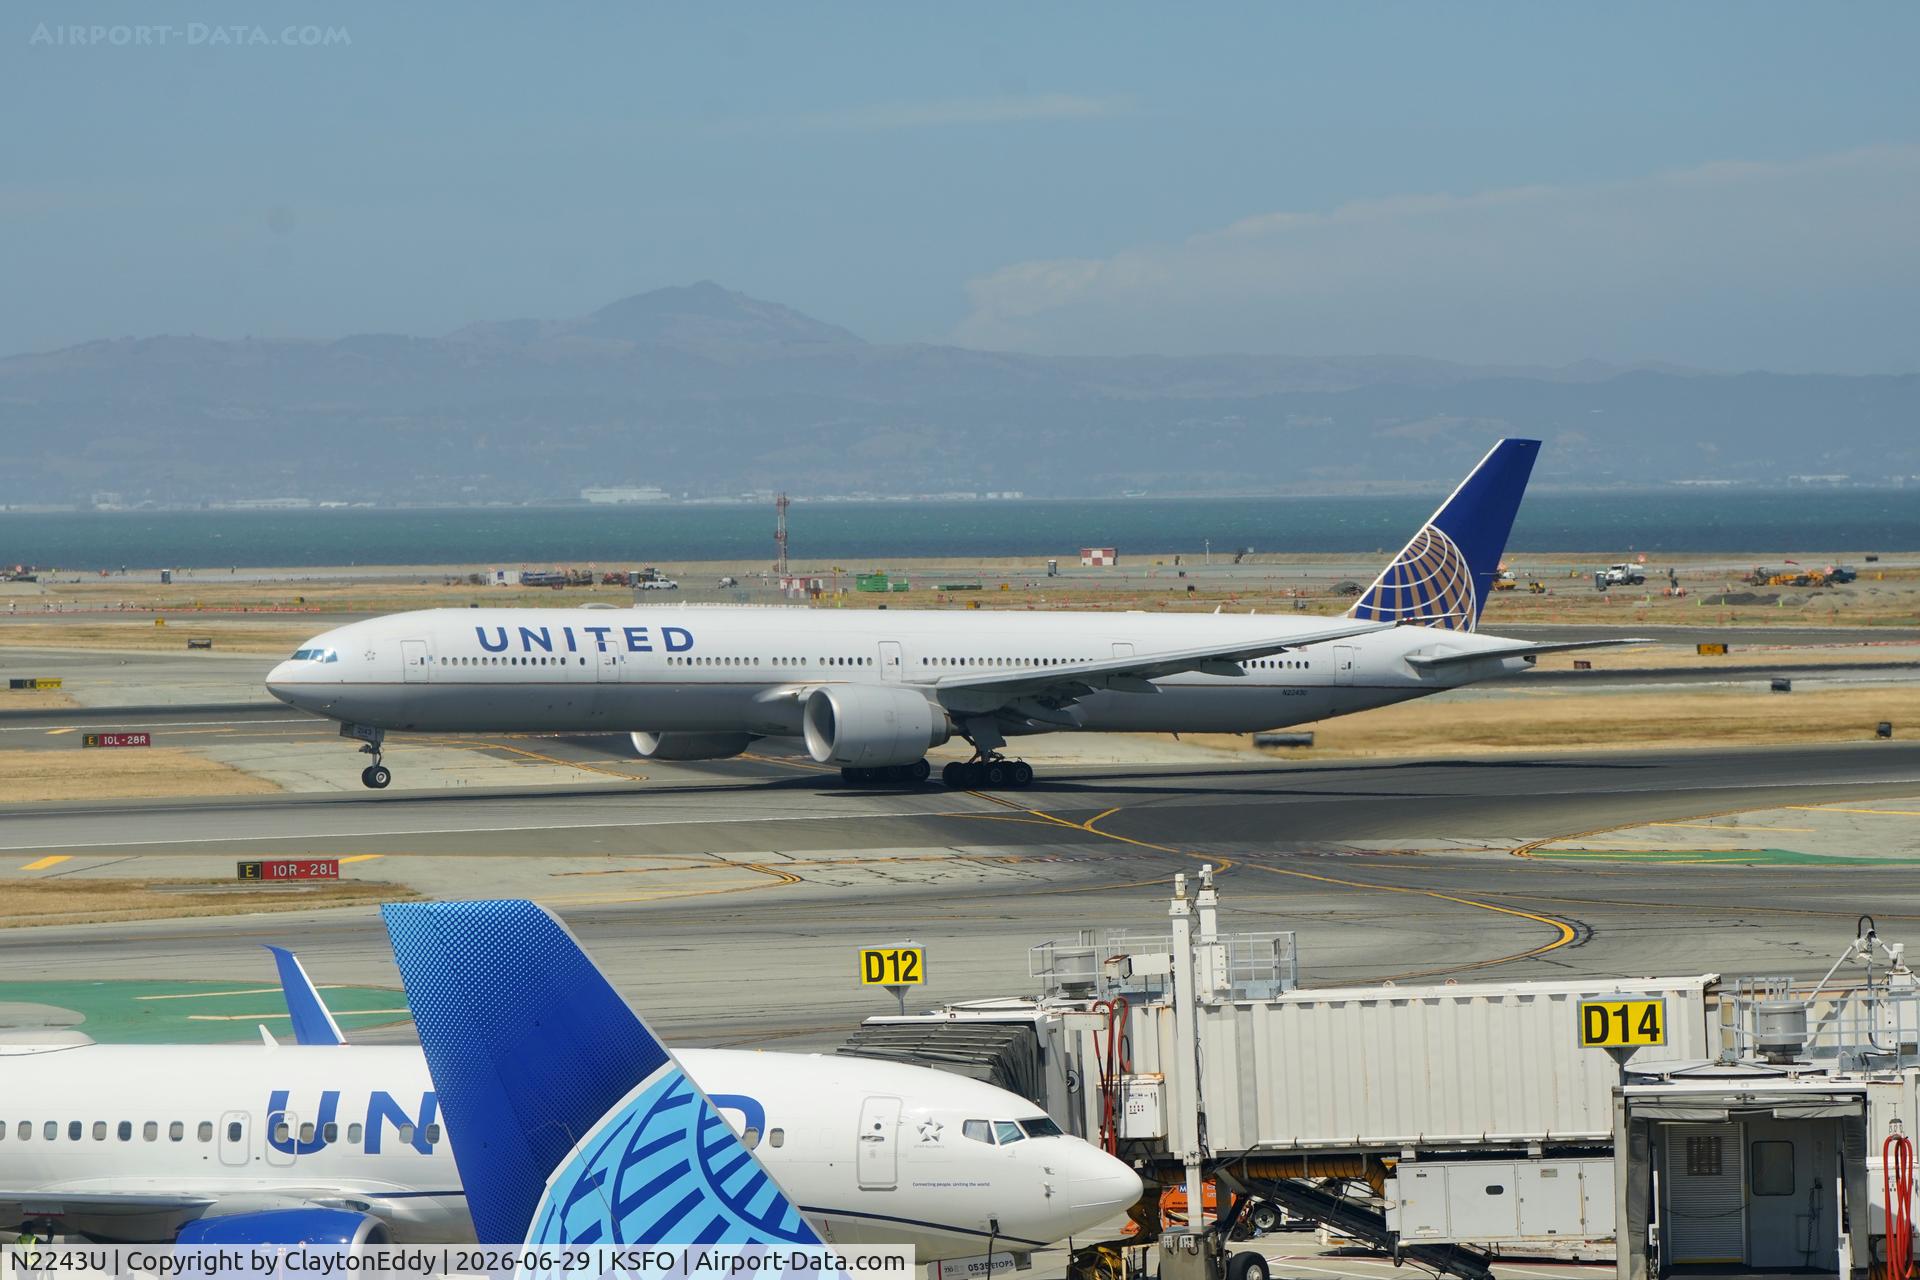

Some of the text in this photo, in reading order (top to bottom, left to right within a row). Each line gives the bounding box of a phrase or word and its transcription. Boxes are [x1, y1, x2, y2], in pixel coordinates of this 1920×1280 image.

[476, 626, 695, 653] UNITED
[88, 736, 94, 745] E
[245, 864, 254, 877] E
[865, 950, 918, 984] D12
[1584, 1003, 1660, 1044] D14
